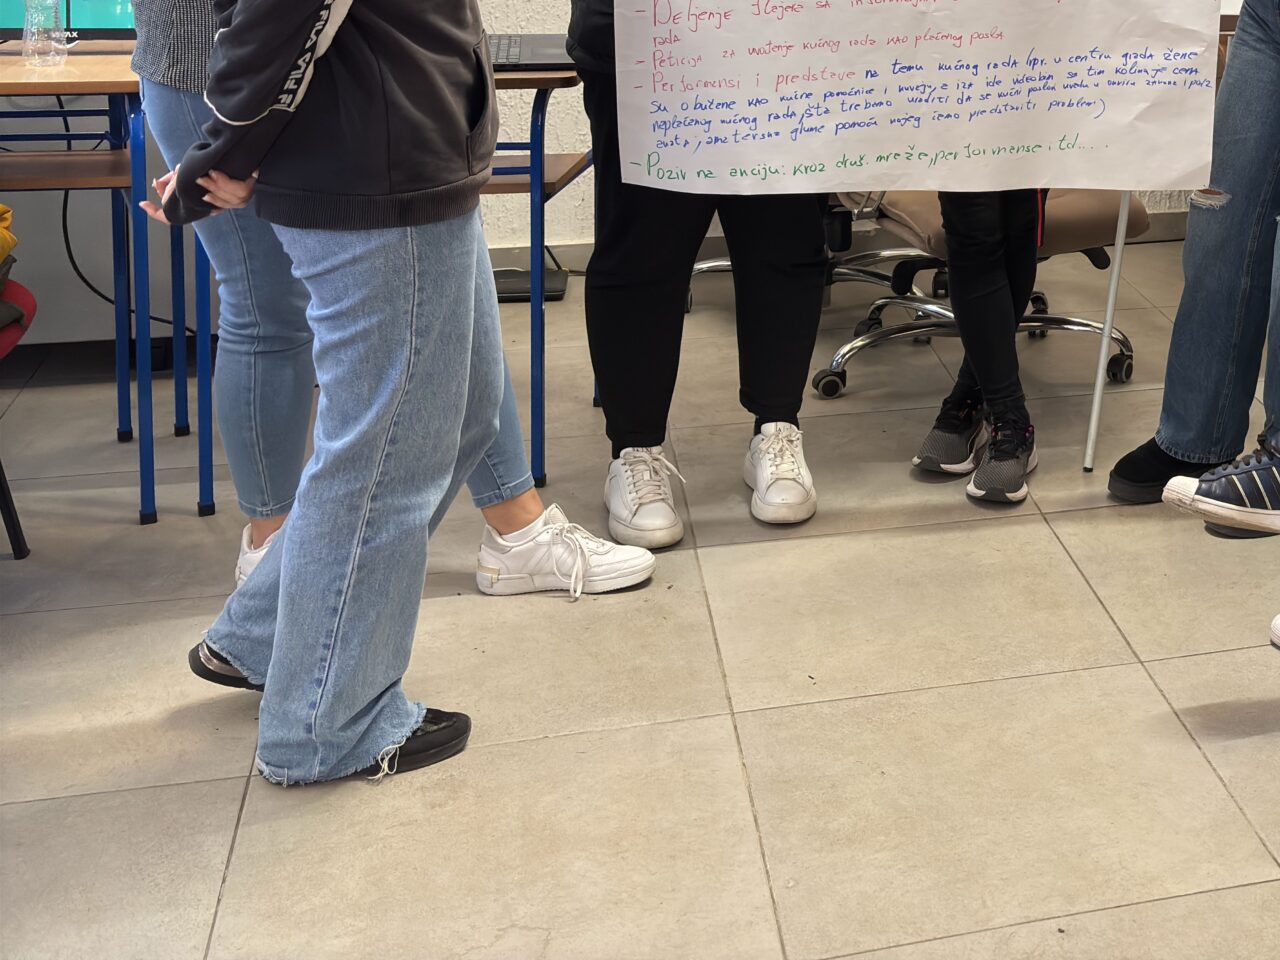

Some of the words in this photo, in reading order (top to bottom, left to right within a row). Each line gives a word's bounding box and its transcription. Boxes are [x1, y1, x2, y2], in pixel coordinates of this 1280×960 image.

[304, 9, 329, 50] FILA
[283, 52, 312, 90] FILA
[891, 58, 924, 75] temu
[1068, 46, 1112, 63] centru
[1163, 47, 1199, 61] žene
[646, 151, 687, 180] Poziv
